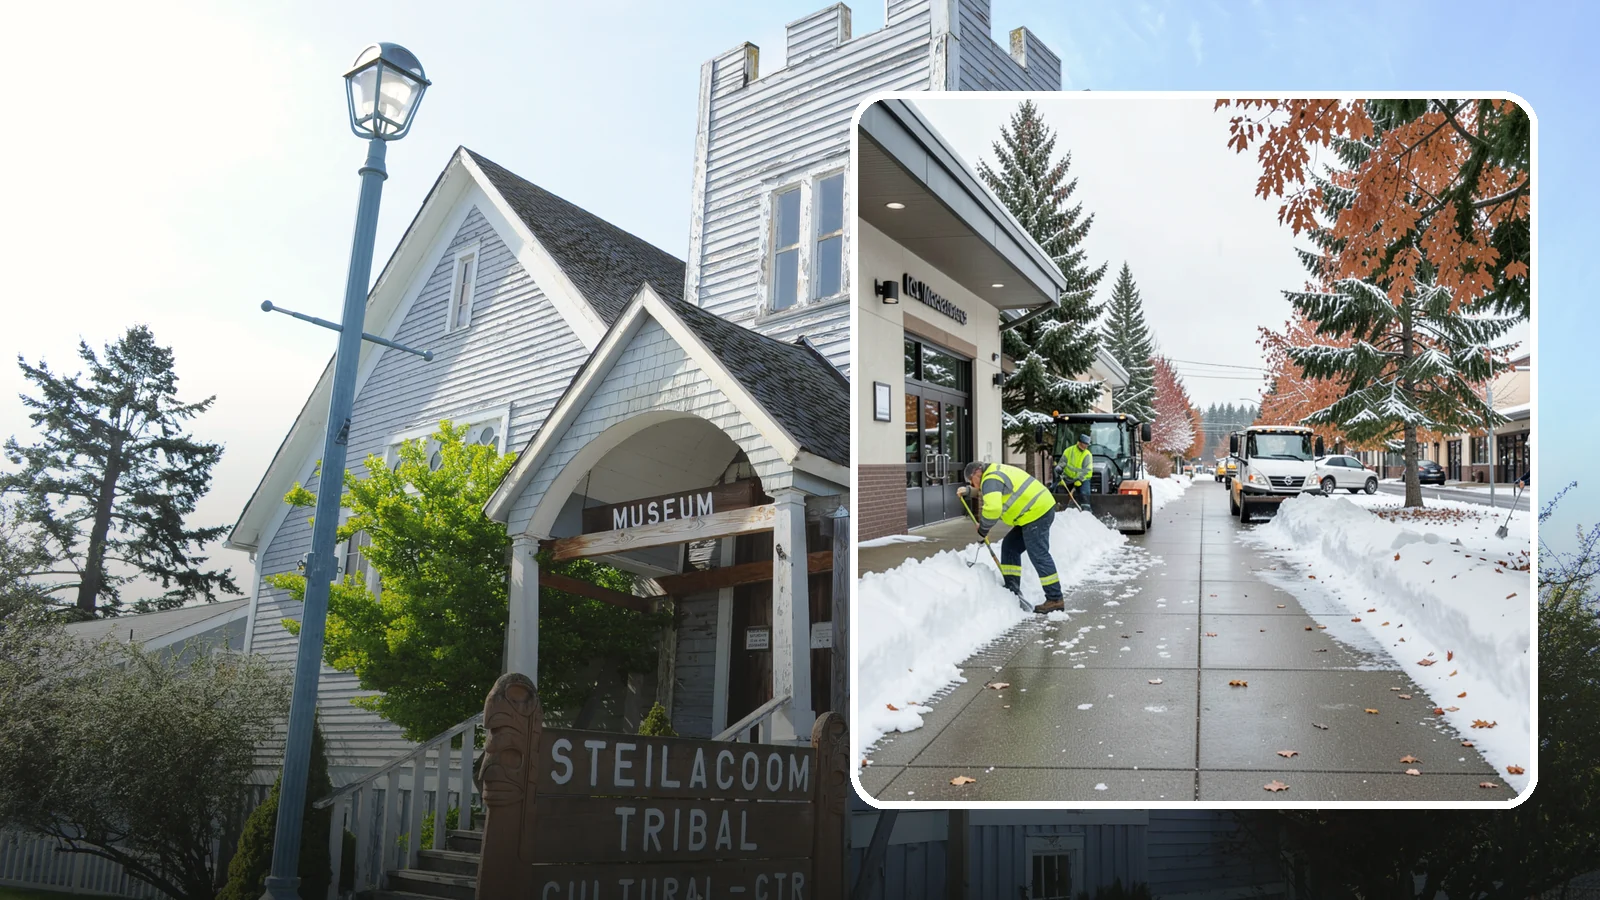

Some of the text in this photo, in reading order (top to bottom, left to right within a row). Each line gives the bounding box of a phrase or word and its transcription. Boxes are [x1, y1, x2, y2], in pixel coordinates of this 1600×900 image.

[612, 491, 714, 531] MUSEUM
[550, 738, 810, 793] STEILACOOM
[614, 806, 758, 852] TRIBAL
